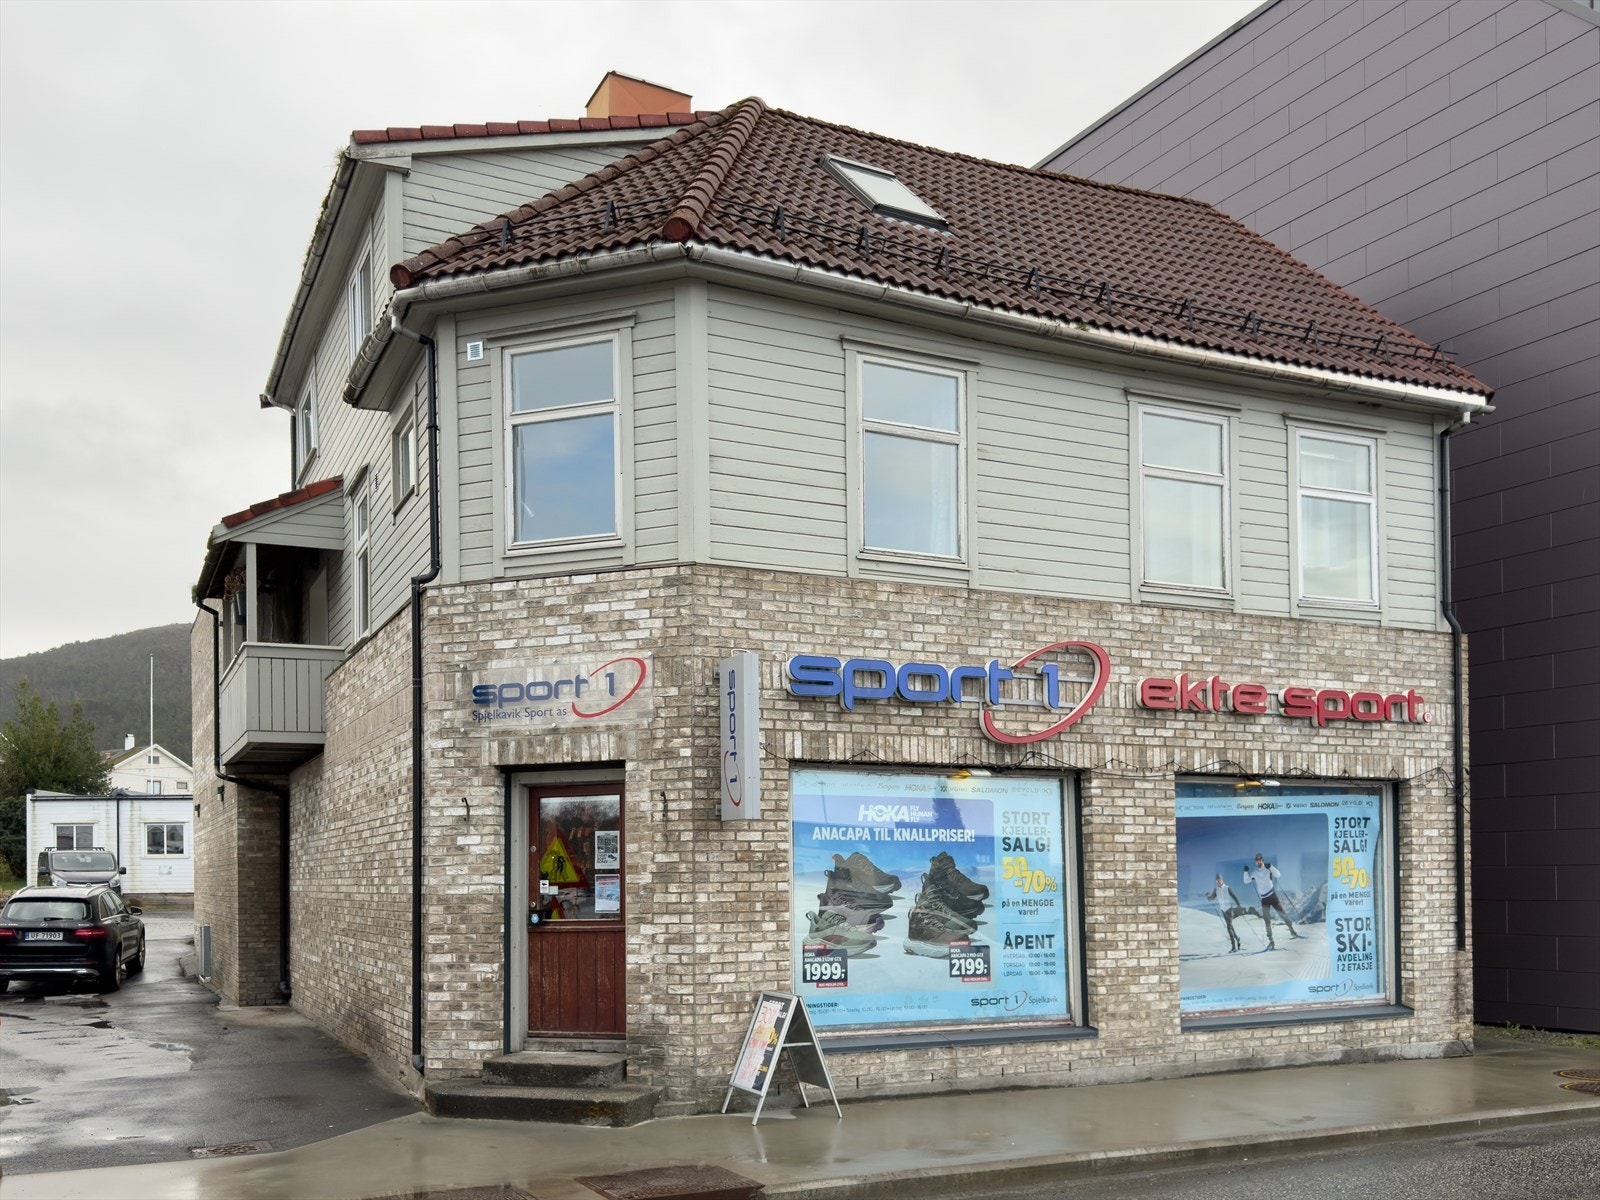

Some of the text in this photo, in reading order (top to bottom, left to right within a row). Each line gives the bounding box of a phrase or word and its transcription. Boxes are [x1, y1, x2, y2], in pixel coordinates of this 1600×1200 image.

[472, 672, 615, 709] sport 1
[787, 655, 1060, 711] sport 1
[1136, 672, 1268, 714] ekte
[472, 707, 567, 722] Spjelkavik Sport as
[727, 669, 737, 762] sport
[858, 804, 909, 822] HOKA
[1002, 811, 1050, 825] STORT
[1334, 816, 1371, 829] STORT
[812, 827, 975, 842] ANACAPA TIL KNALLPRISER!
[1002, 826, 1051, 836] KJELLER-
[1002, 836, 1051, 852] SALG!
[1333, 839, 1368, 853] SALG!
[1331, 891, 1338, 900] på
[1001, 899, 1010, 909] på
[1021, 899, 1054, 907] MENGDE
[1335, 917, 1371, 932] STOR
[1003, 931, 1055, 950] ÅPENT
[1336, 933, 1372, 953] SKI-
[1337, 953, 1373, 962] AVDELING
[1341, 963, 1346, 972] 2
[1347, 962, 1373, 971] ETASJE
[1308, 984, 1339, 994] sport
[971, 996, 1009, 1007] sport
